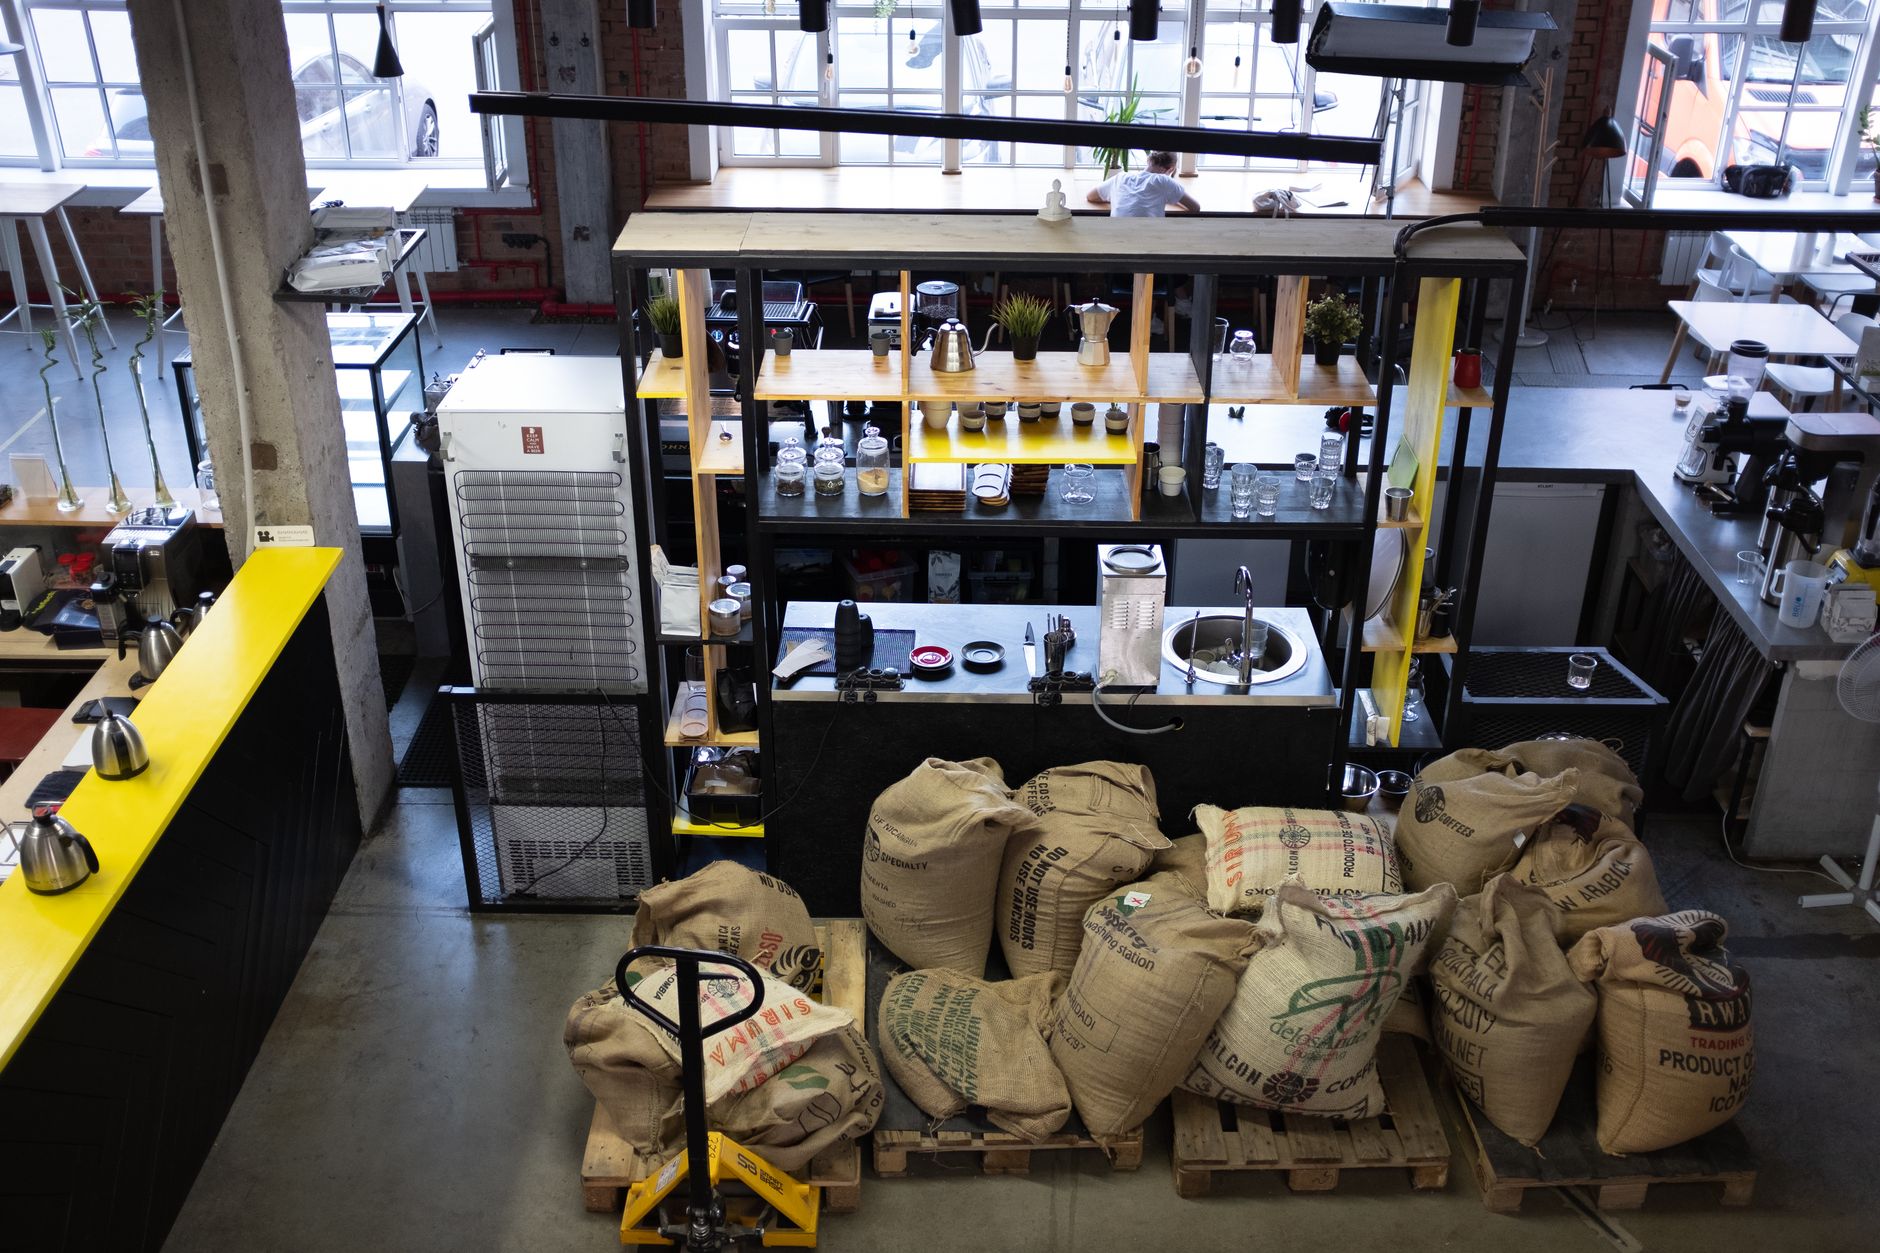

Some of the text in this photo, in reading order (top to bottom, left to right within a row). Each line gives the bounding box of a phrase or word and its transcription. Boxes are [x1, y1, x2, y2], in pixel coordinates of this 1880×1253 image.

[1438, 814, 1475, 838] COFFEES
[880, 852, 928, 871] SPECIALTY
[1288, 849, 1300, 876] ALCON
[1343, 840, 1355, 878] PRODUCTO
[759, 874, 775, 889] NO
[1009, 843, 1049, 943] NO USE GANCHOS
[1579, 860, 1634, 902] ARABICA
[1021, 846, 1068, 950] DO NOT USE HOOKS
[1086, 920, 1156, 972] washing station
[708, 998, 812, 1068] SIRUMA
[1690, 1036, 1745, 1051] TRADING
[1206, 1031, 1264, 1086] FALCON
[1659, 1049, 1740, 1077] PRODUCT
[1709, 1094, 1737, 1113] ICO
